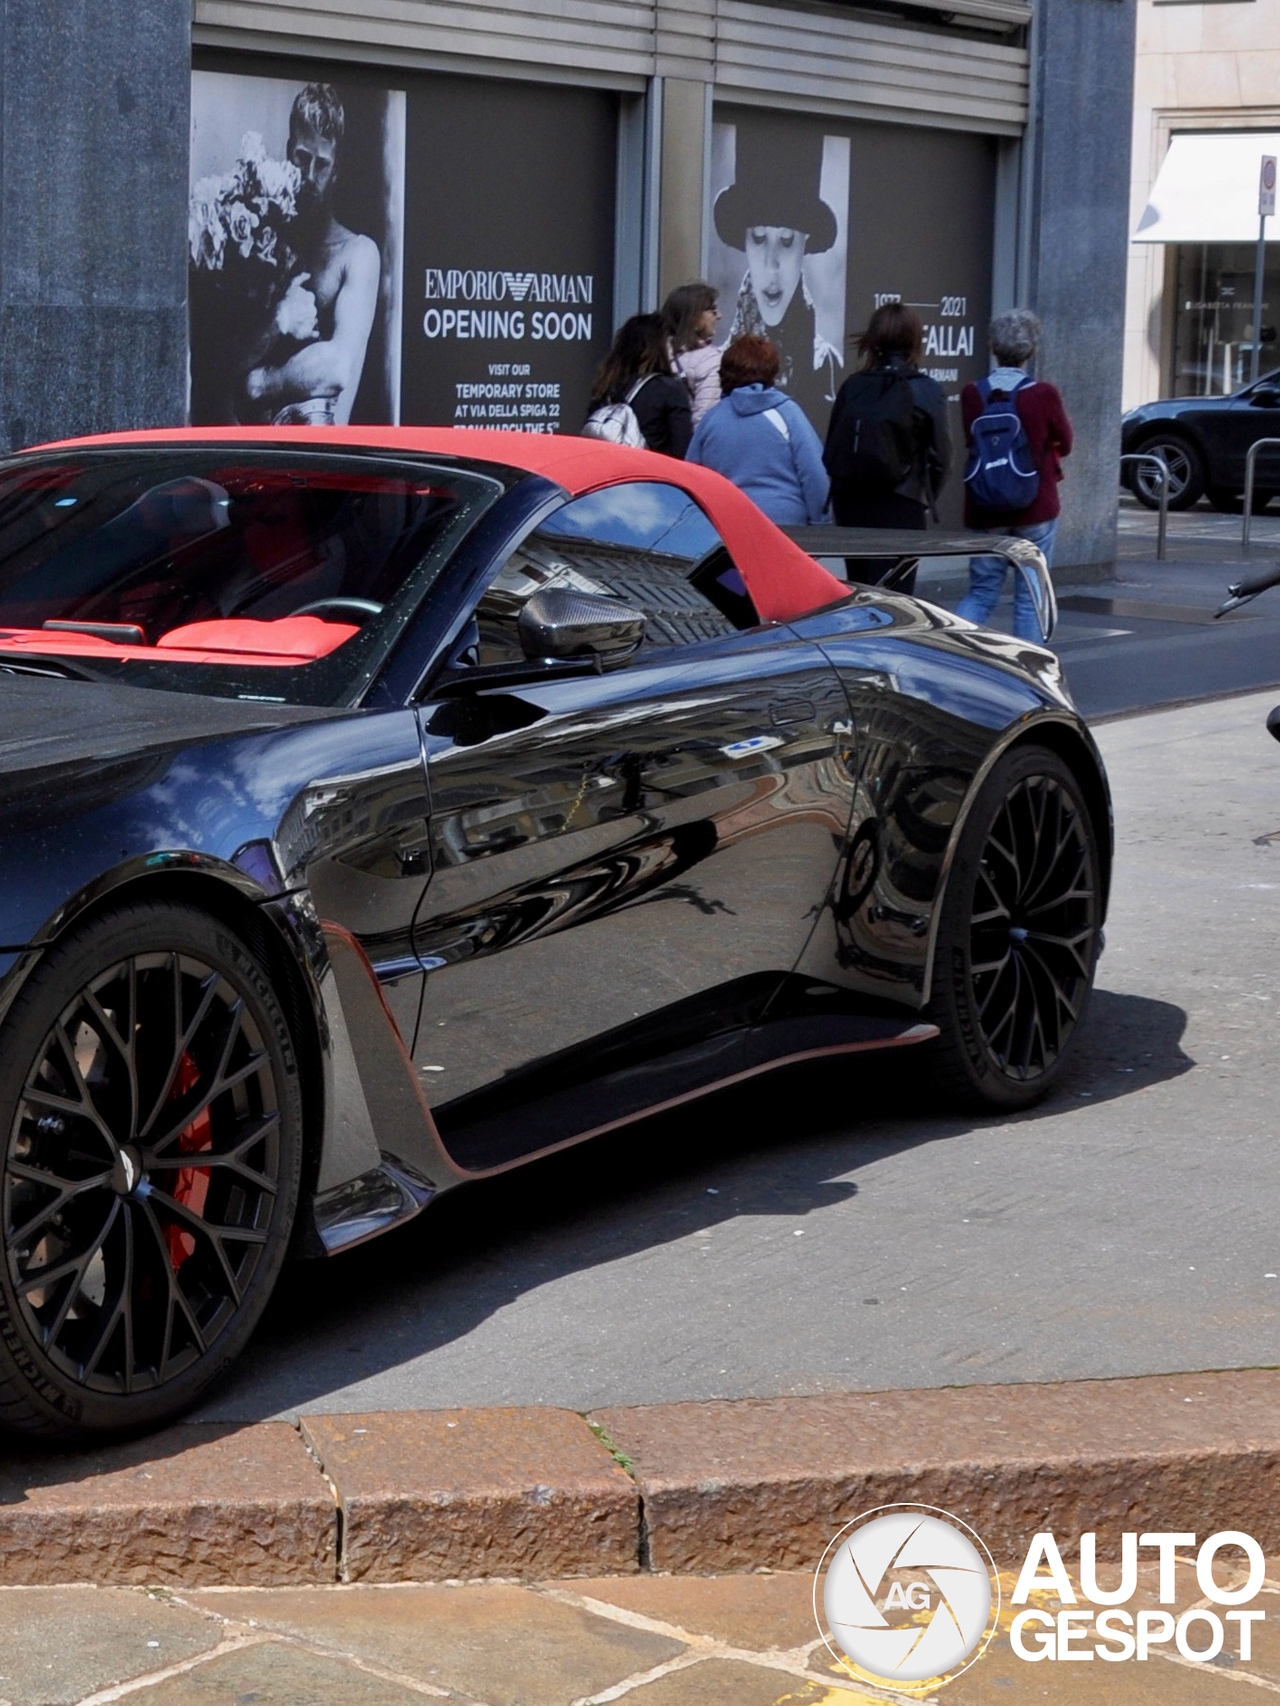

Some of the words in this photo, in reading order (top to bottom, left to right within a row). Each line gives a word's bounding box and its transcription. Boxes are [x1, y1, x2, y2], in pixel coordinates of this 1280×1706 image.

[425, 268, 506, 301] EMPORIO
[528, 274, 594, 304] ARMANI
[941, 297, 966, 317] 2021
[423, 308, 525, 340] OPENING
[531, 312, 592, 341] SOON
[488, 364, 510, 376] VISIT
[511, 364, 531, 376] OUR
[455, 383, 523, 399] TEMPORARY
[525, 384, 561, 398] STORE
[454, 405, 468, 418] AT
[470, 404, 487, 418] VIA
[488, 404, 519, 418] DELLA
[520, 404, 548, 417] SPIGA
[548, 404, 560, 417] 22
[235, 956, 295, 1067] MICHELIN
